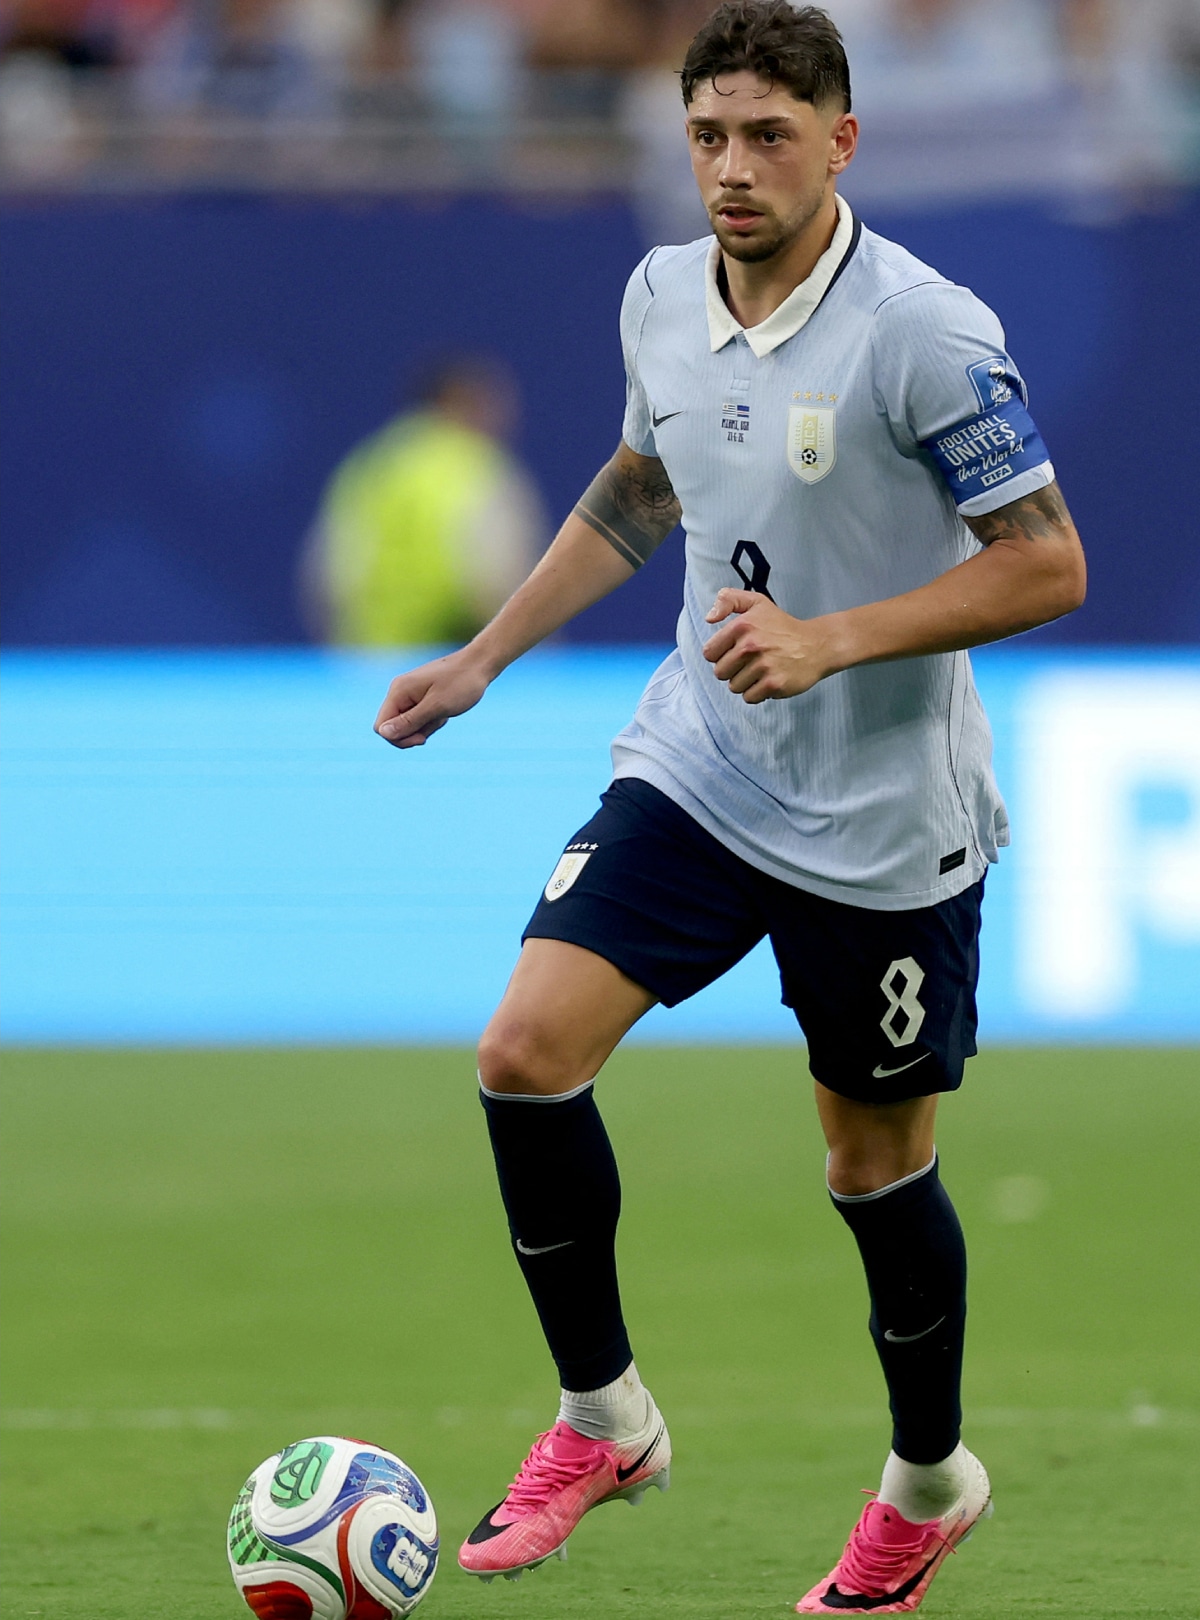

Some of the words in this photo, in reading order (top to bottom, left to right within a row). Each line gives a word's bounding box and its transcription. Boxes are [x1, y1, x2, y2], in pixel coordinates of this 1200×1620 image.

[937, 415, 1006, 452] FOOTBALL
[944, 423, 1016, 466] UNITES
[956, 465, 980, 483] the
[979, 437, 1025, 471] World
[982, 467, 1011, 485] FIFA
[879, 956, 926, 1048] 8
